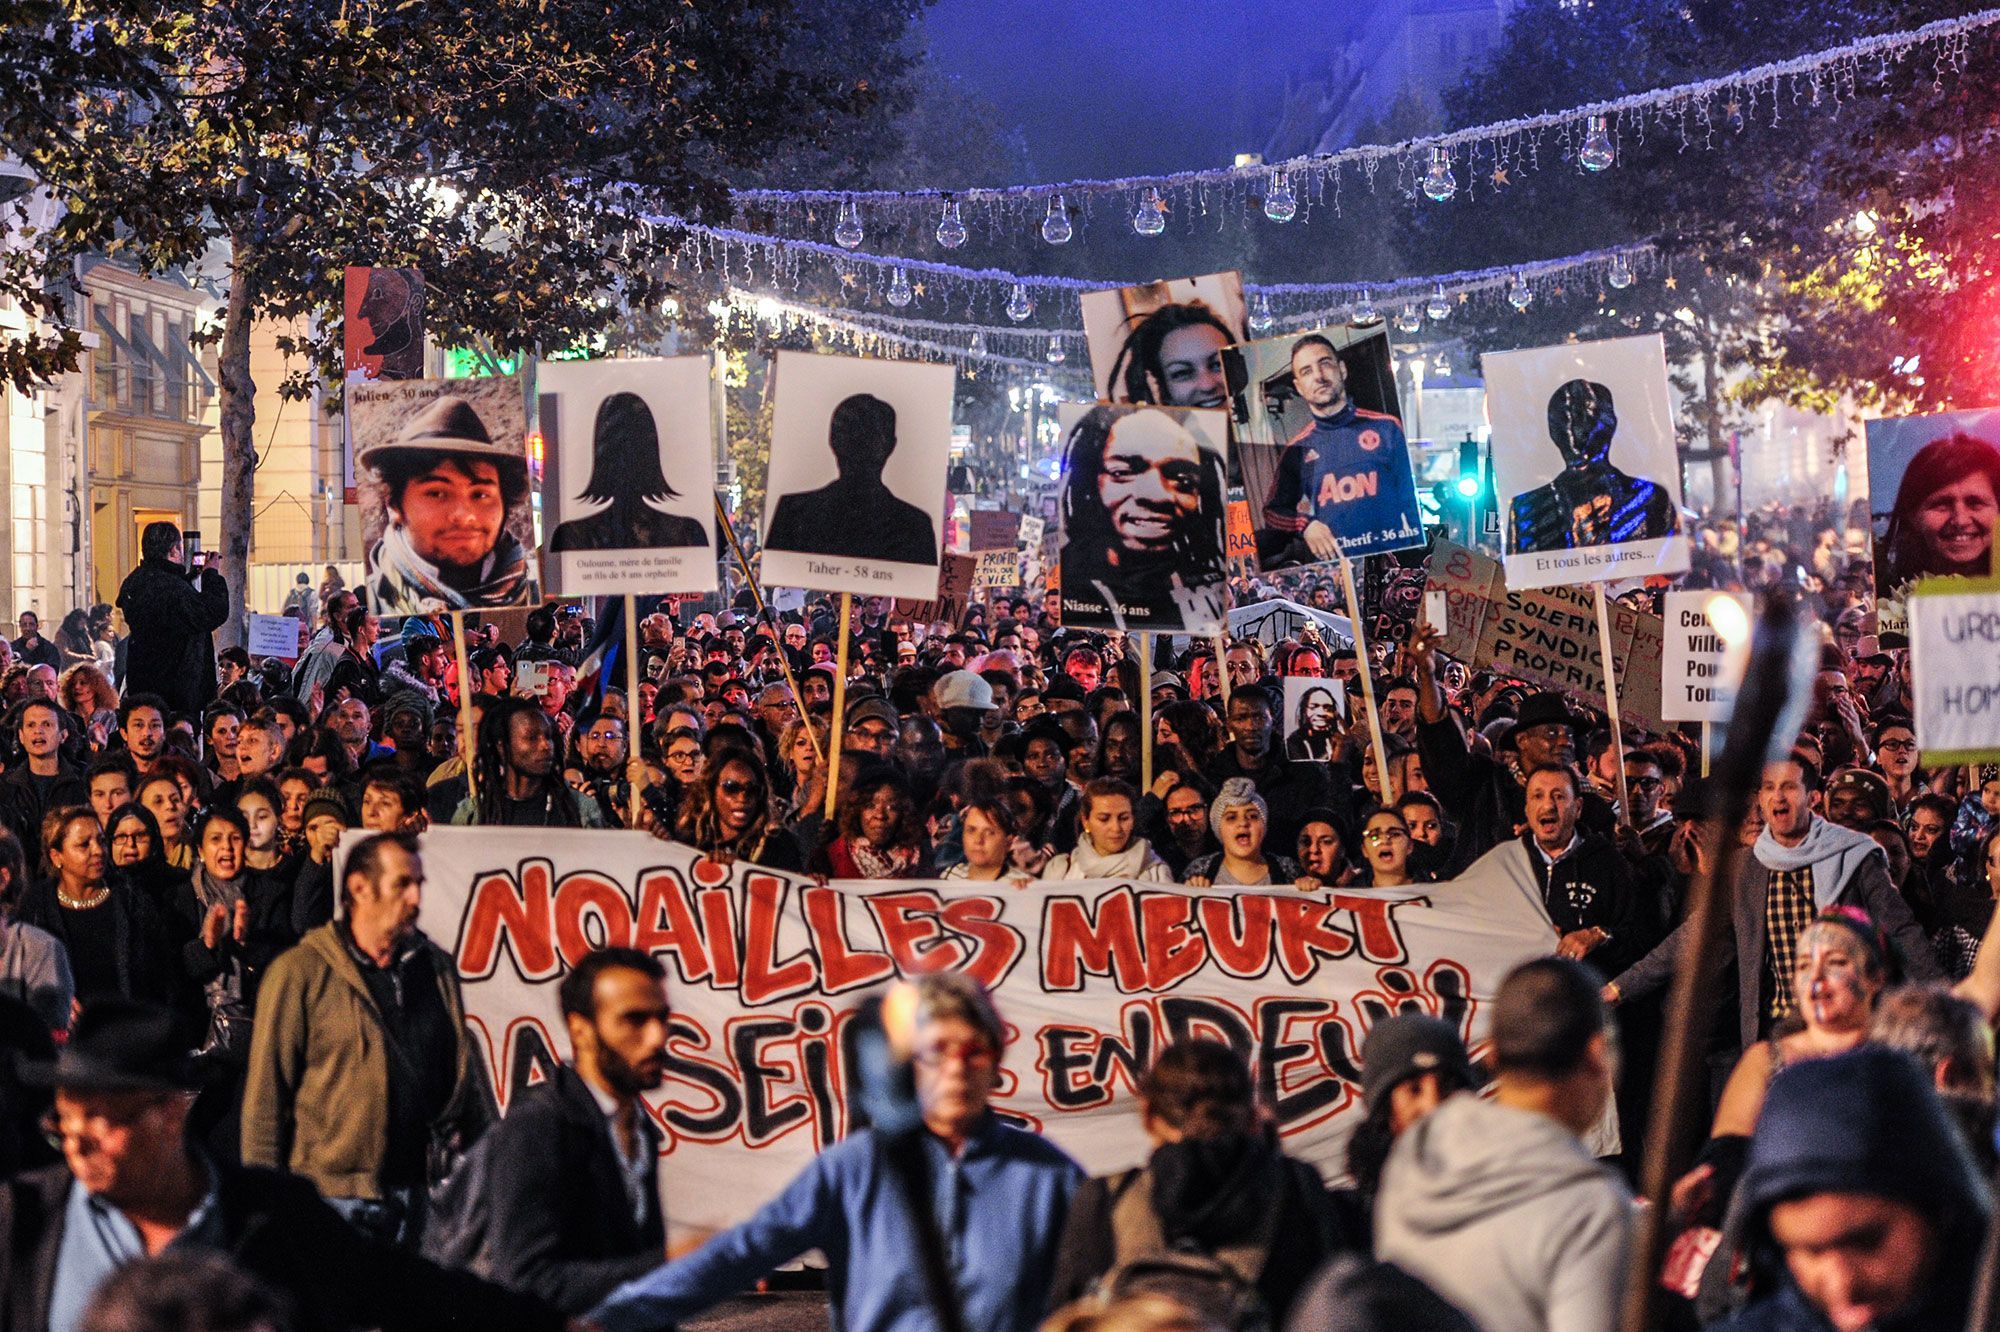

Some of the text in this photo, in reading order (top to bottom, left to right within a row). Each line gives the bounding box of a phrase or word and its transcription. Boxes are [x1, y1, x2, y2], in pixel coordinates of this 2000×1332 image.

[354, 391, 390, 406] Julien
[401, 388, 416, 399] 30
[419, 388, 440, 398] ans
[1317, 471, 1378, 508] AON
[1382, 529, 1396, 541] 36
[1398, 526, 1420, 539] ans
[641, 556, 652, 566] de
[653, 555, 682, 566] famille
[1536, 549, 1655, 571] Et tous les autres...
[582, 569, 678, 581] un fils de 8 ans orphelin
[807, 560, 841, 576] Taher
[853, 566, 869, 579] 58
[872, 568, 894, 581] ans
[988, 574, 1013, 585] VIES
[1063, 599, 1102, 613] Niasse
[1128, 605, 1151, 616] ans
[1880, 620, 1910, 633] Mari
[1686, 660, 1719, 678] Pou
[1685, 685, 1718, 703] Tou
[1039, 884, 1433, 994] MEURT
